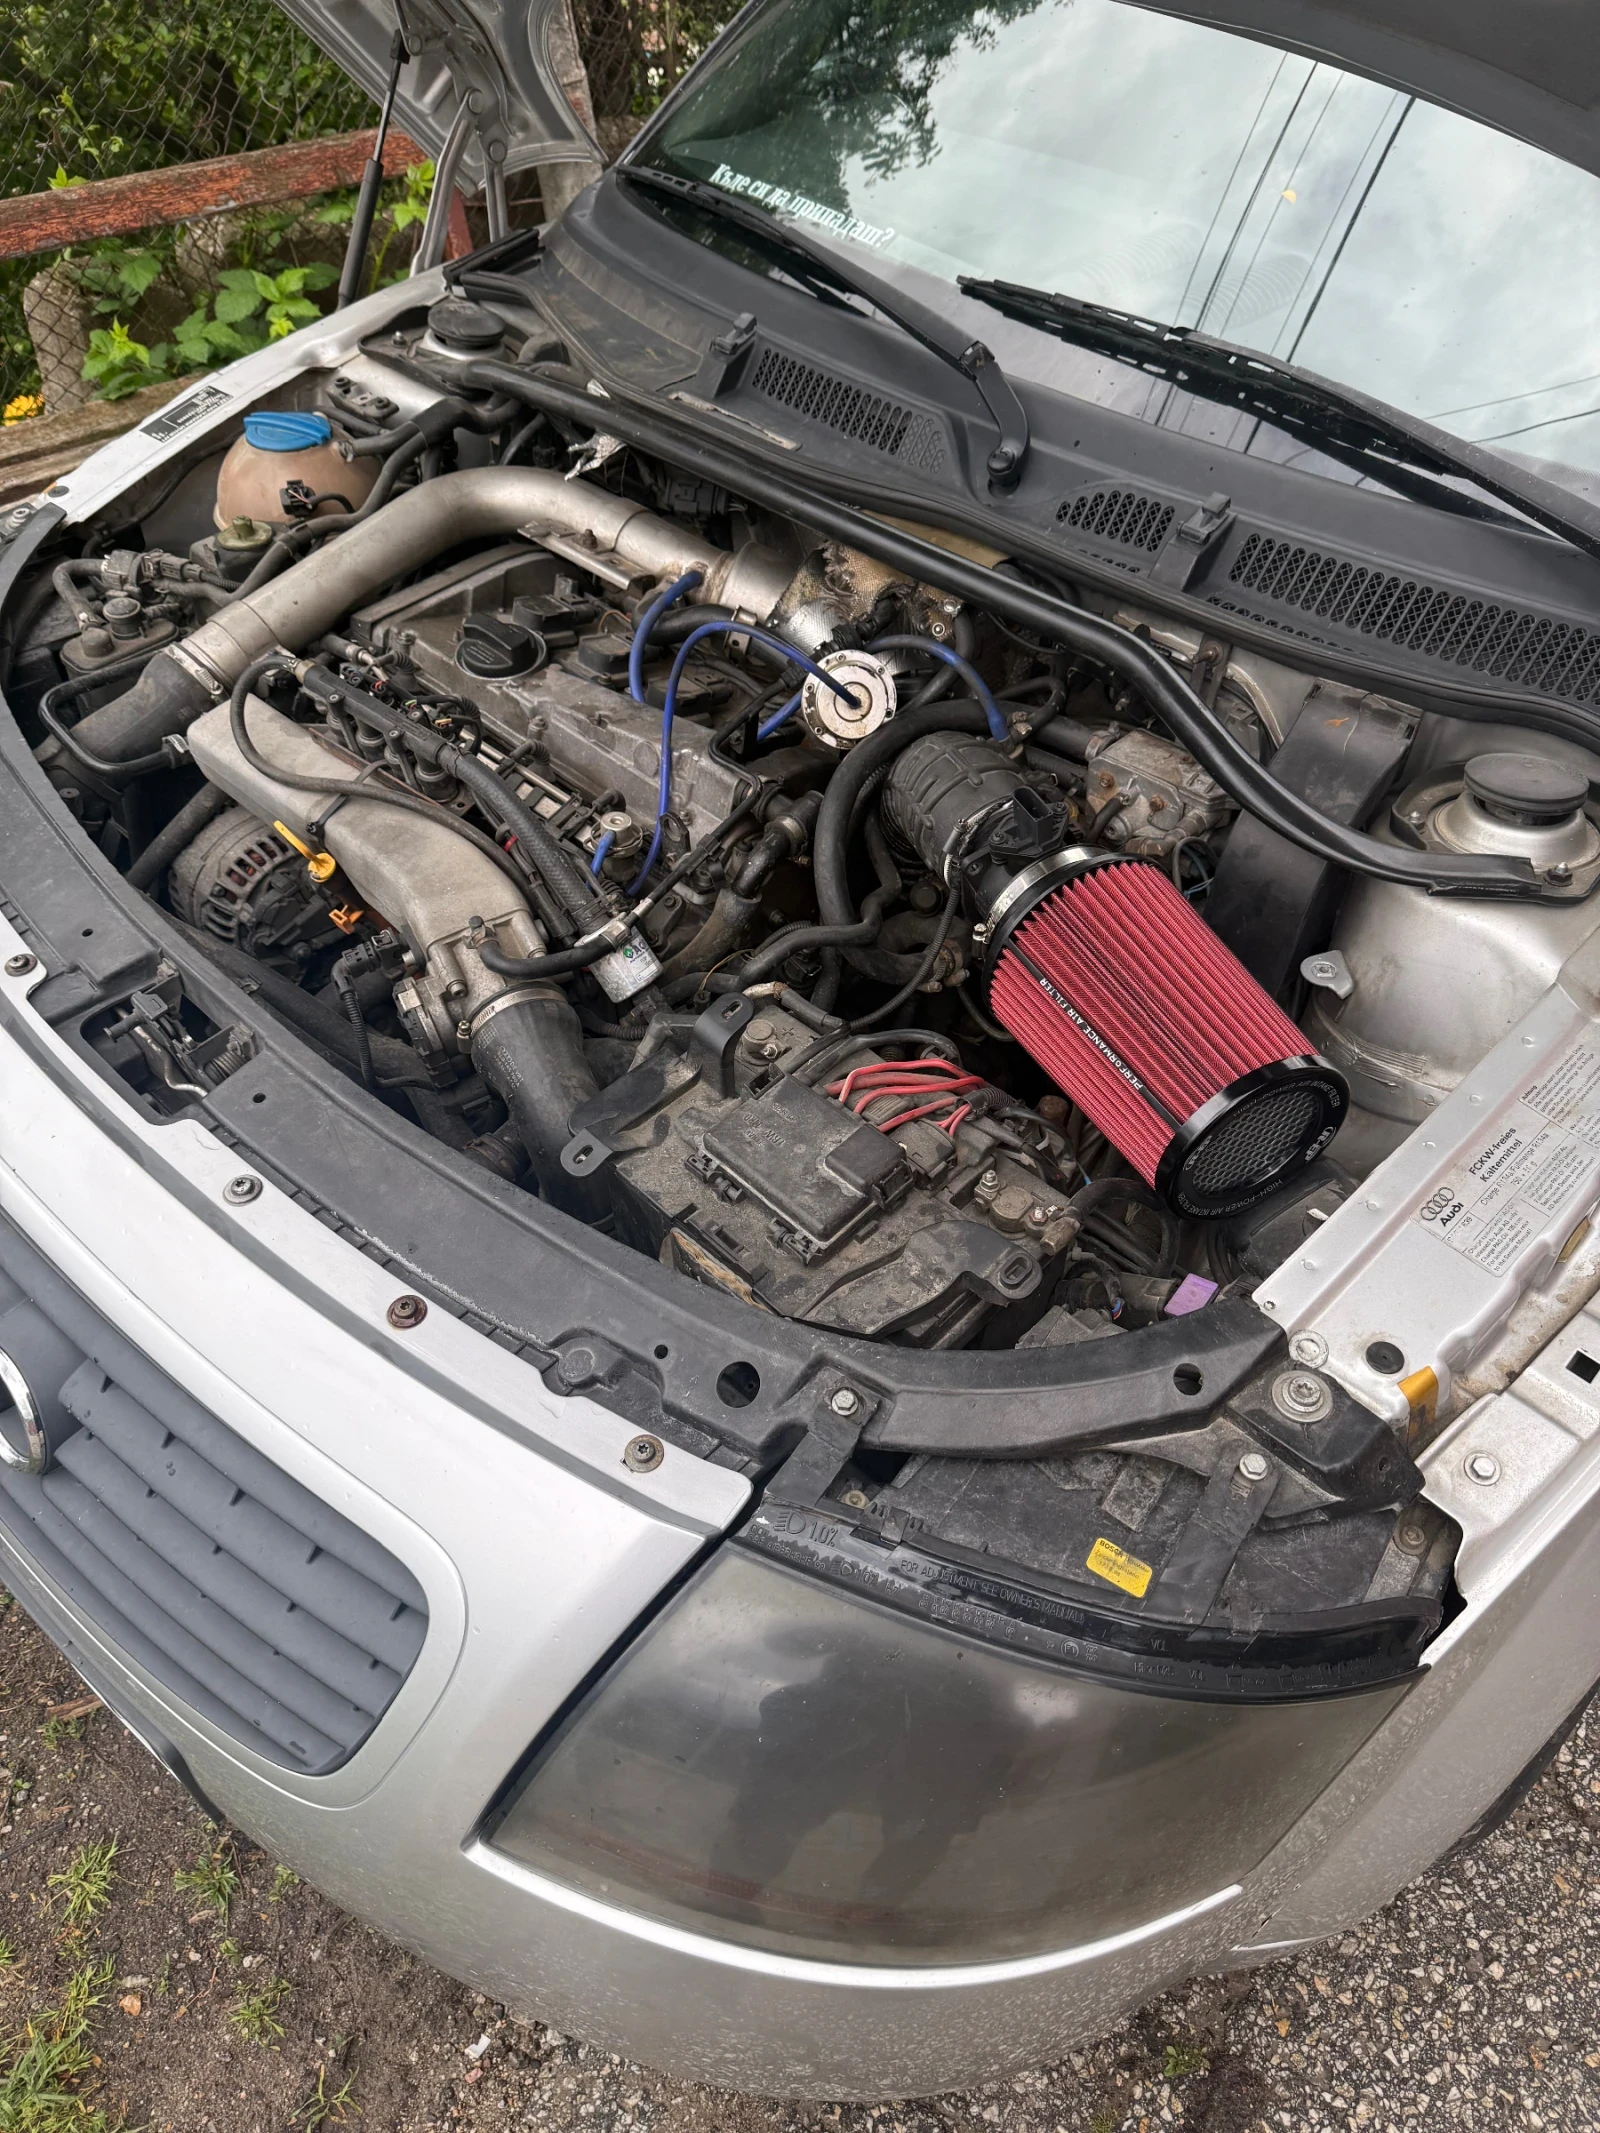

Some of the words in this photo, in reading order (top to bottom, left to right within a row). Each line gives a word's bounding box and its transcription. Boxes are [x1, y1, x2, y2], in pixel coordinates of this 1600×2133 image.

[709, 163, 750, 192] Къде
[763, 187, 791, 209] да
[788, 194, 895, 247] припадаш?
[1040, 978, 1067, 1007] FILTER
[1067, 1008, 1083, 1024] AIR
[1084, 1026, 1141, 1089] PERFORMANCE
[1469, 1127, 1516, 1175] FCKW-freies
[1480, 1139, 1523, 1182] Kältemittel
[1481, 1186, 1499, 1205] Charge
[1440, 1202, 1464, 1226] Audi
[808, 1521, 839, 1547] 1.0%
[899, 1559, 918, 1573] FOR
